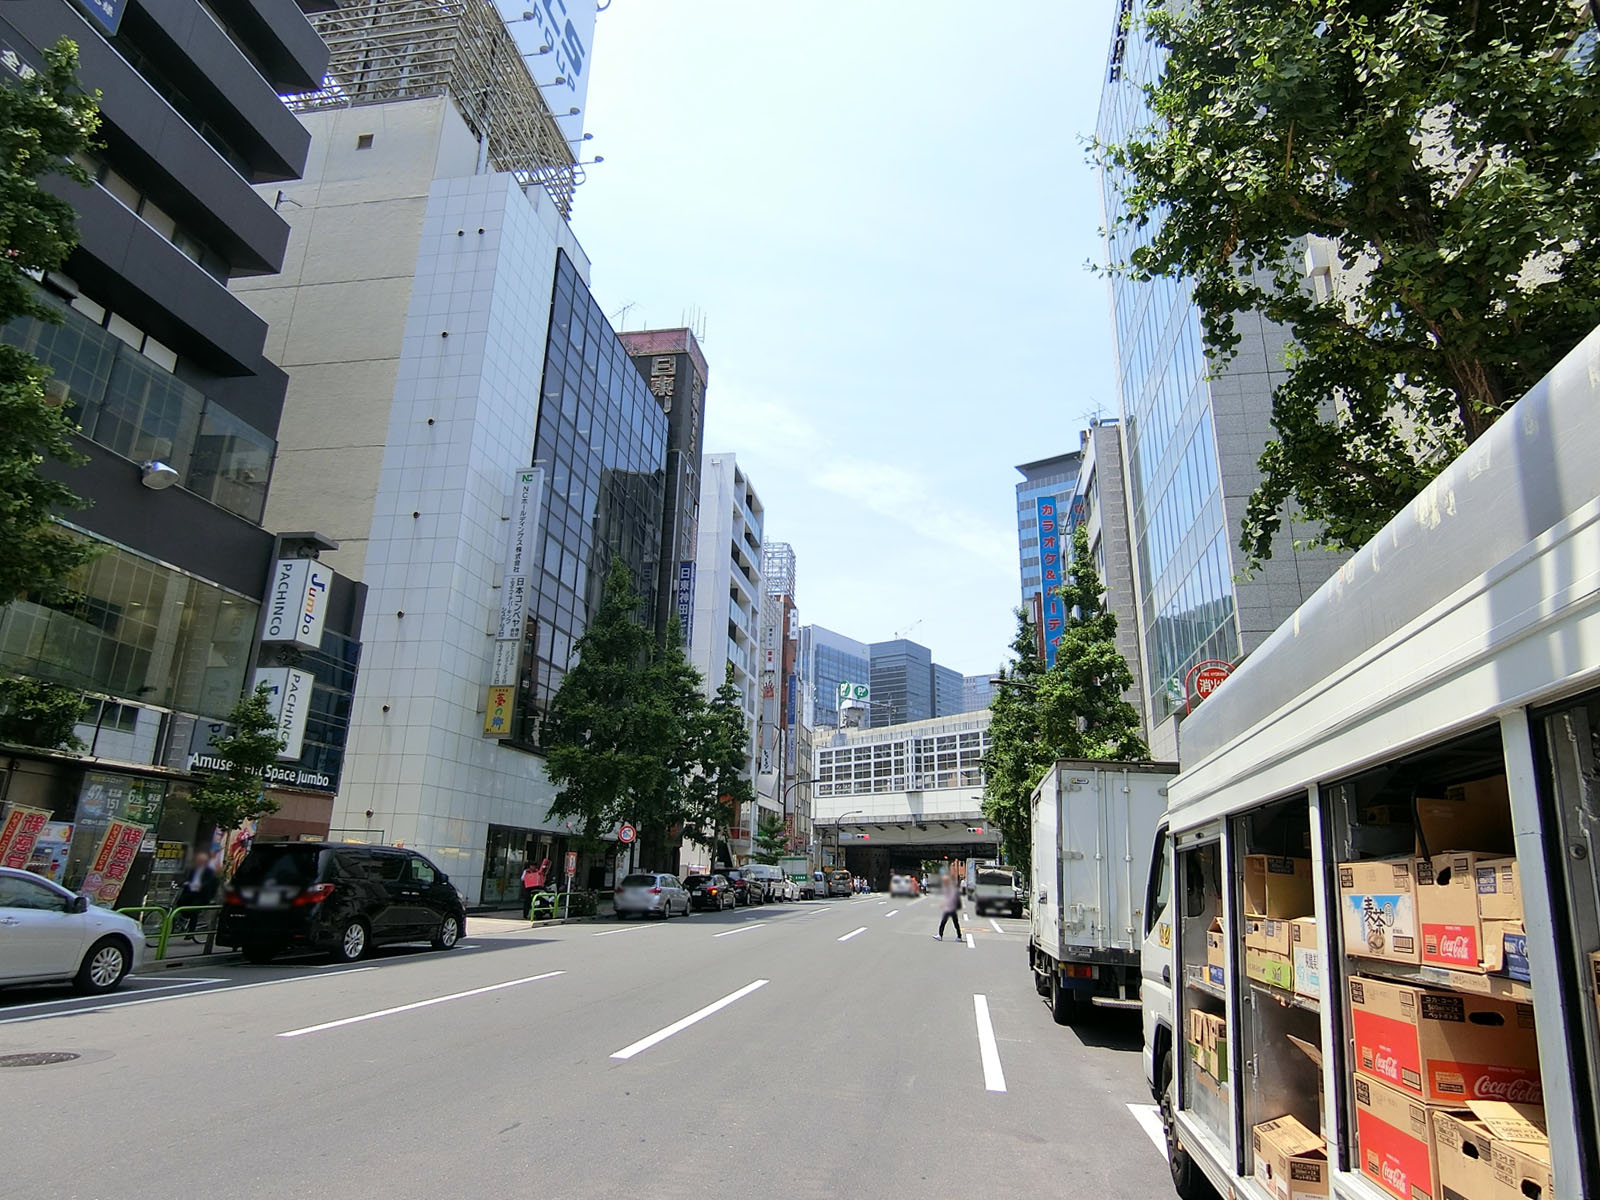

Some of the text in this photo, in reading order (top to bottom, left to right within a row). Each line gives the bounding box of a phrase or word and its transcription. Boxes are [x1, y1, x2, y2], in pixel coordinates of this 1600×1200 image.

[526, 0, 575, 92] ROUP
[269, 563, 293, 636] PACHINCO
[302, 573, 326, 635] Jumbo
[1199, 679, 1224, 693] 消火
[264, 764, 296, 782] Space
[296, 770, 330, 787] Jumbo
[1363, 896, 1386, 936] 麦茶
